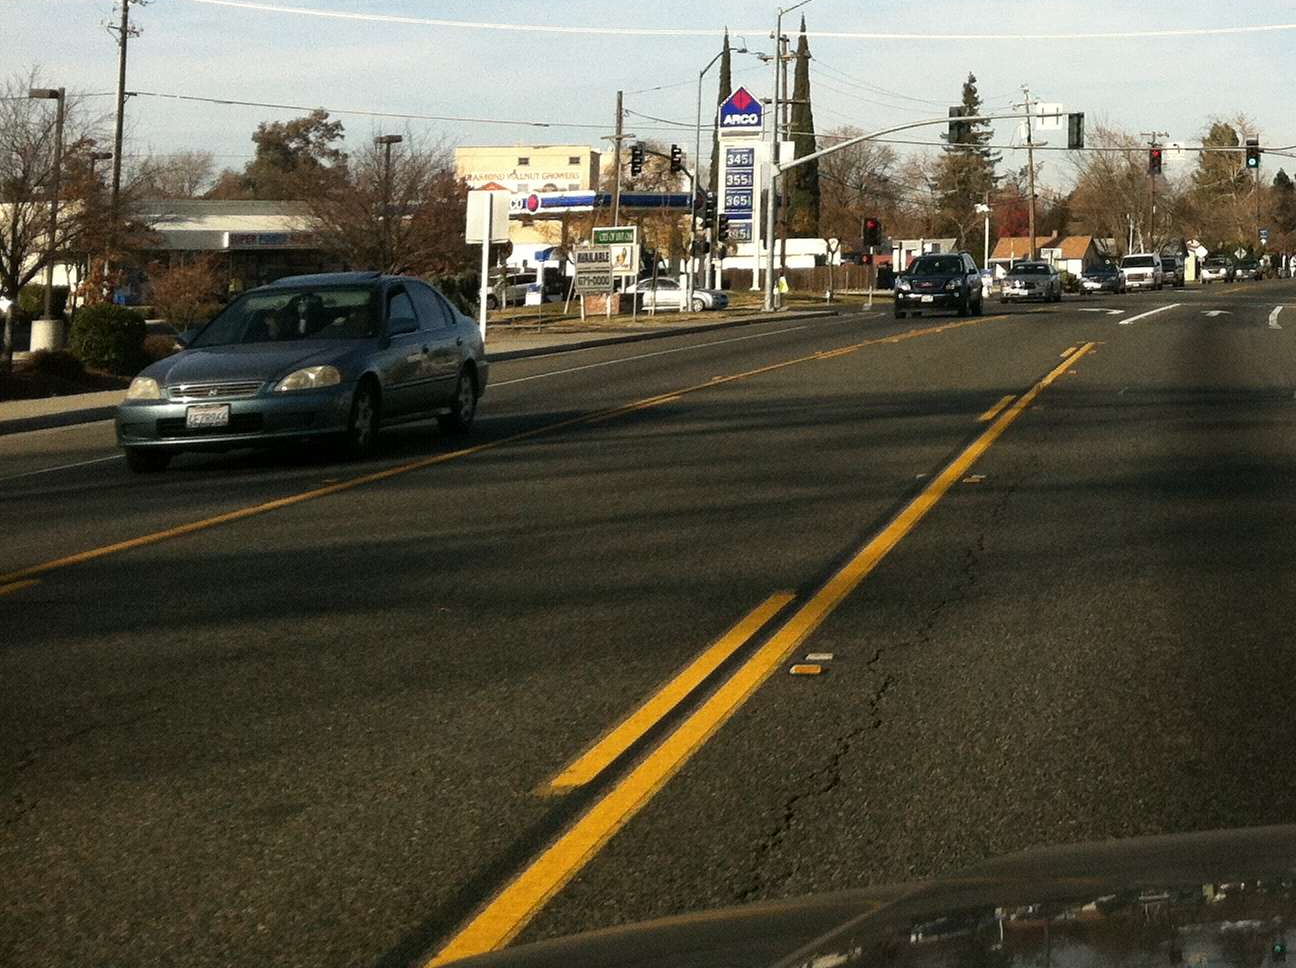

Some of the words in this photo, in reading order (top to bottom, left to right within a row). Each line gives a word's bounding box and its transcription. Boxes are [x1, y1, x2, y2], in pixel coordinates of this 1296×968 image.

[723, 113, 759, 125] ARCO
[727, 153, 749, 165] 345
[506, 170, 539, 182] WALNUT
[726, 174, 748, 186] 355
[725, 195, 747, 207] 365
[576, 251, 610, 263] AVAILABLE
